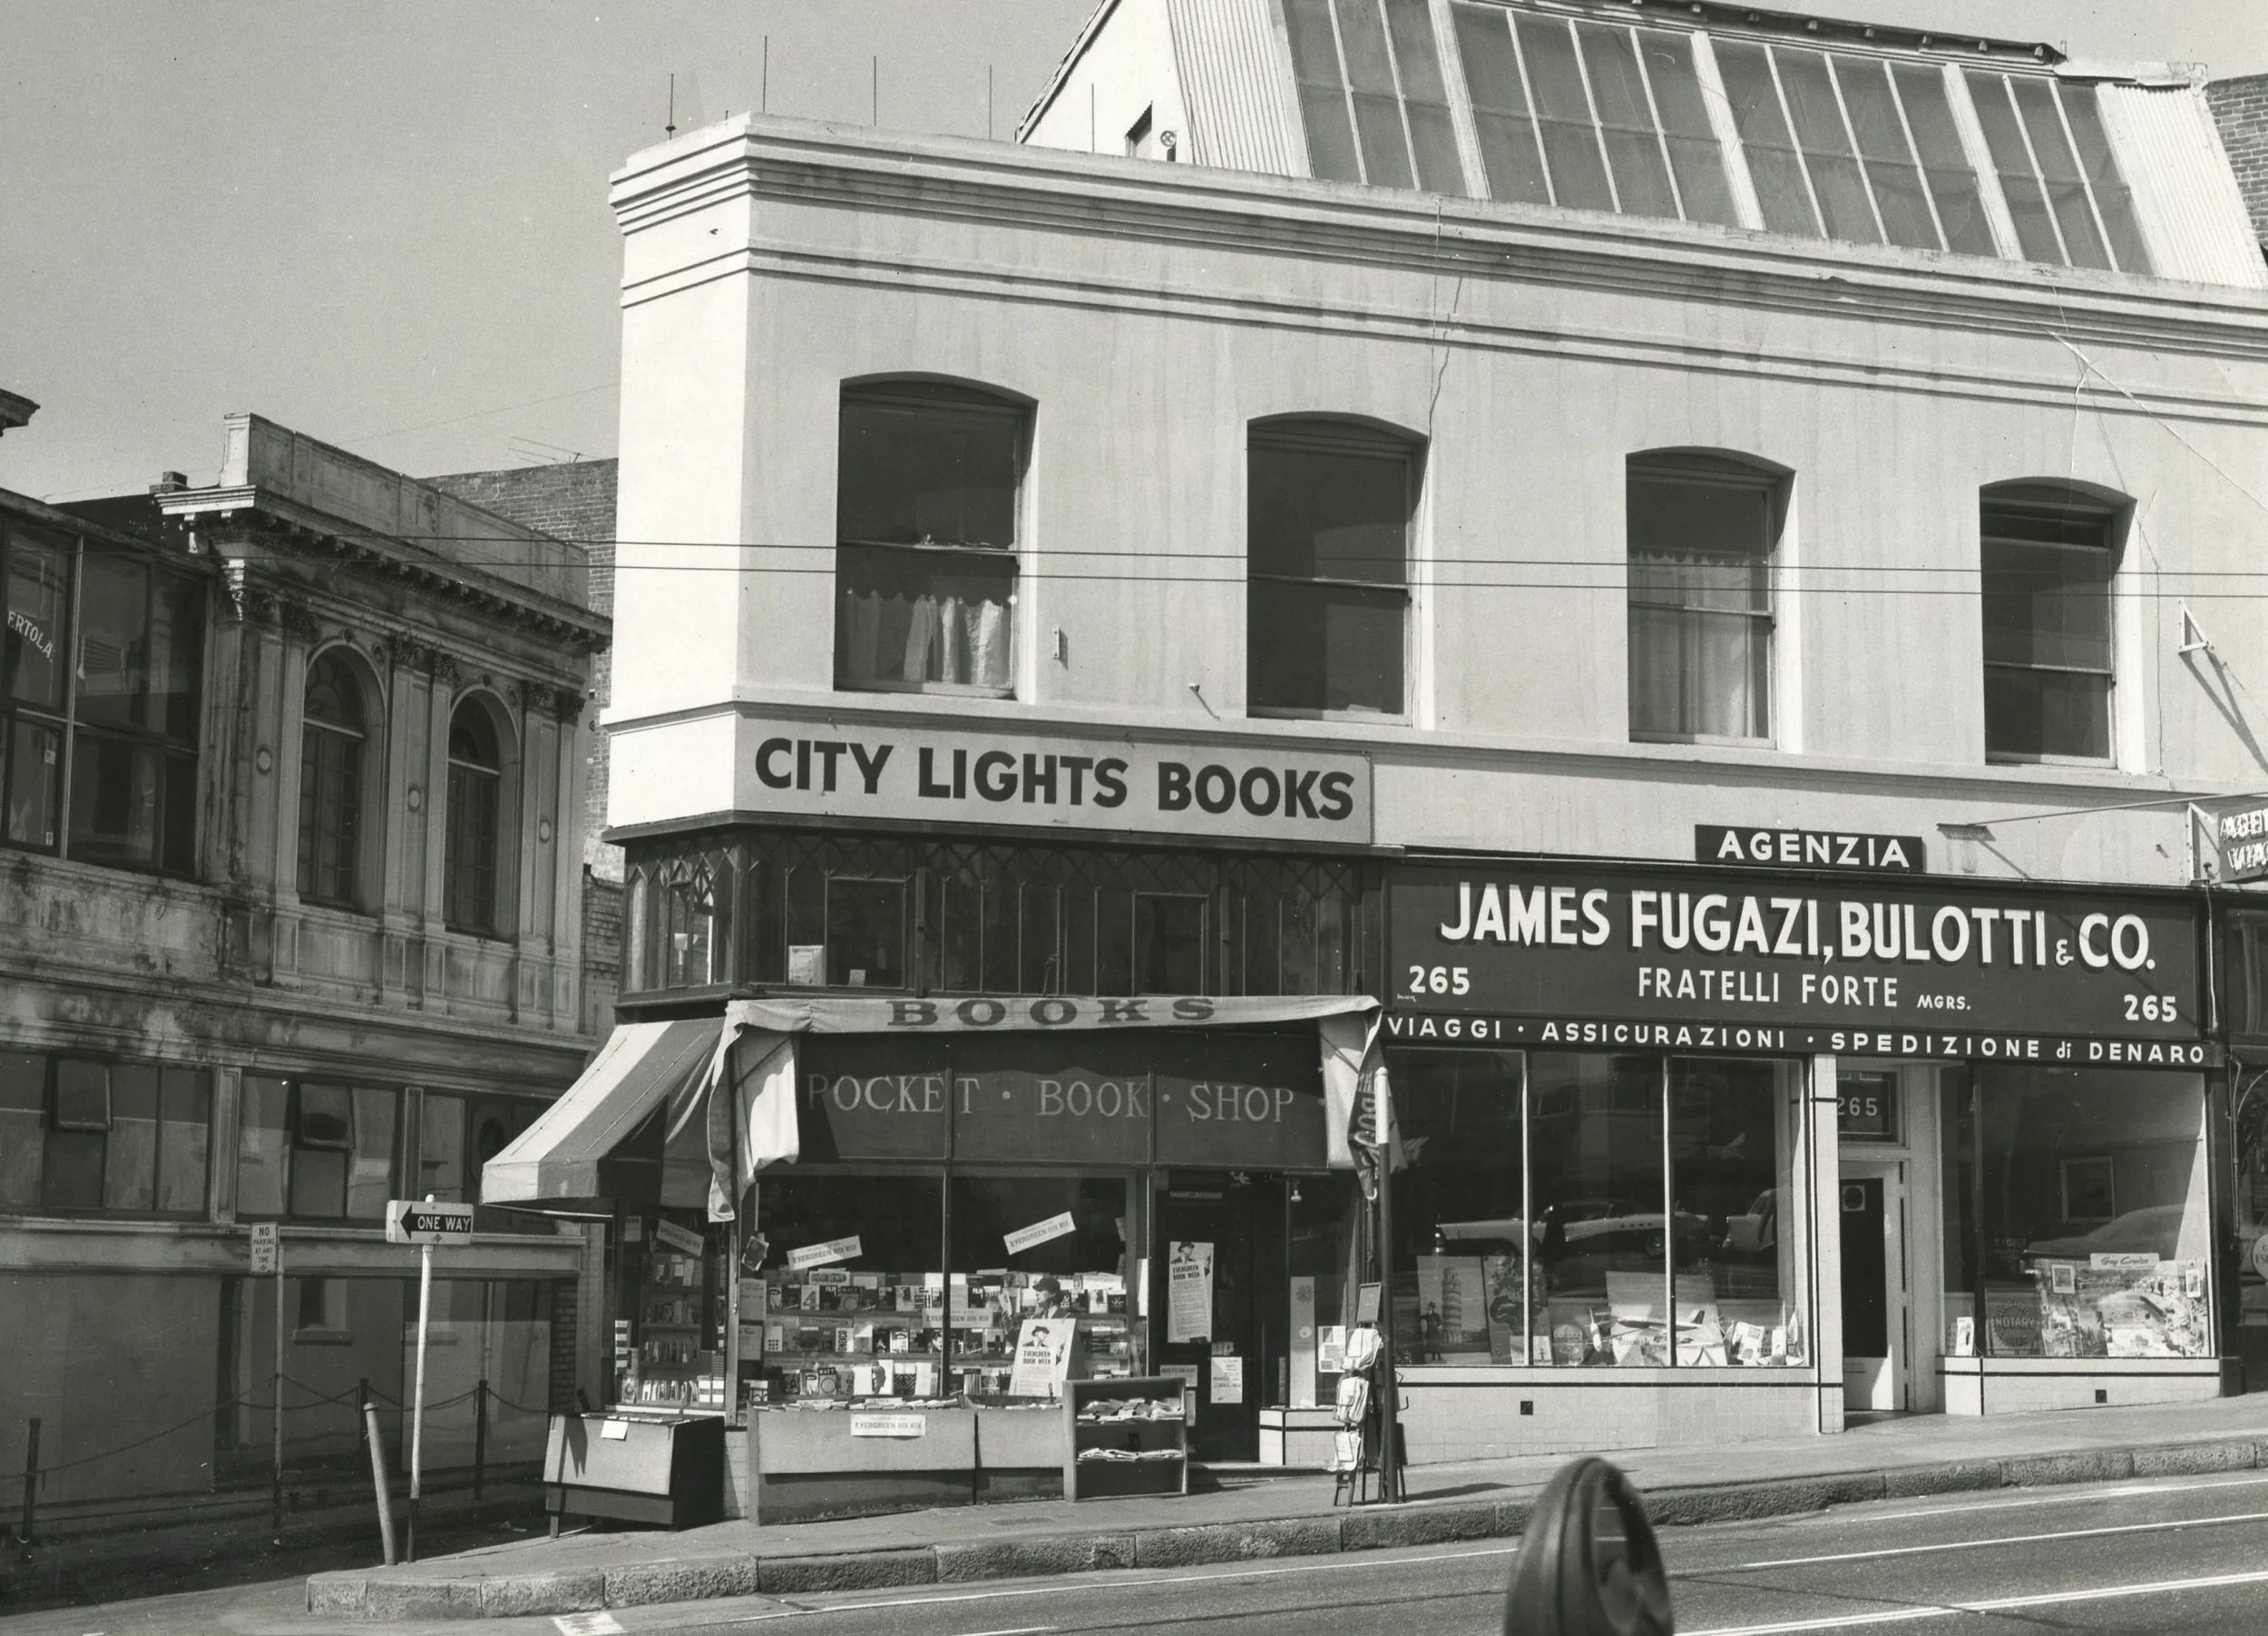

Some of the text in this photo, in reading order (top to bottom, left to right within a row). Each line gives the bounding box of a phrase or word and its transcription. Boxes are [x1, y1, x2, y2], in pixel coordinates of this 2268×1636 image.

[755, 738, 1355, 821] CITY LIGHTS BOOKS
[1716, 830, 1910, 867] AGENZIA
[1441, 881, 2156, 970] JAMES FUGAZI, BULOTTI & CO.
[1409, 965, 1471, 995] 265
[1638, 966, 1971, 1010] FRATELLI FORTE MGRS.
[885, 998, 1215, 1026] BOOKS
[2124, 994, 2177, 1023] 265
[1386, 1016, 2204, 1063] VIAGGI ASSICURAZIONI SPEDIZIONE di DENARO
[807, 1073, 1295, 1122] POCKET BOOK SHOP
[1837, 1096, 1878, 1117] 265
[259, 1227, 270, 1236] NO
[417, 1216, 471, 1231] ONE WAY
[1172, 1265, 1199, 1273] EVERGREEN
[1188, 1271, 1200, 1279] WEEK
[1995, 1317, 2035, 1328] NOTARY
[855, 1421, 896, 1429] EVERGREEN
